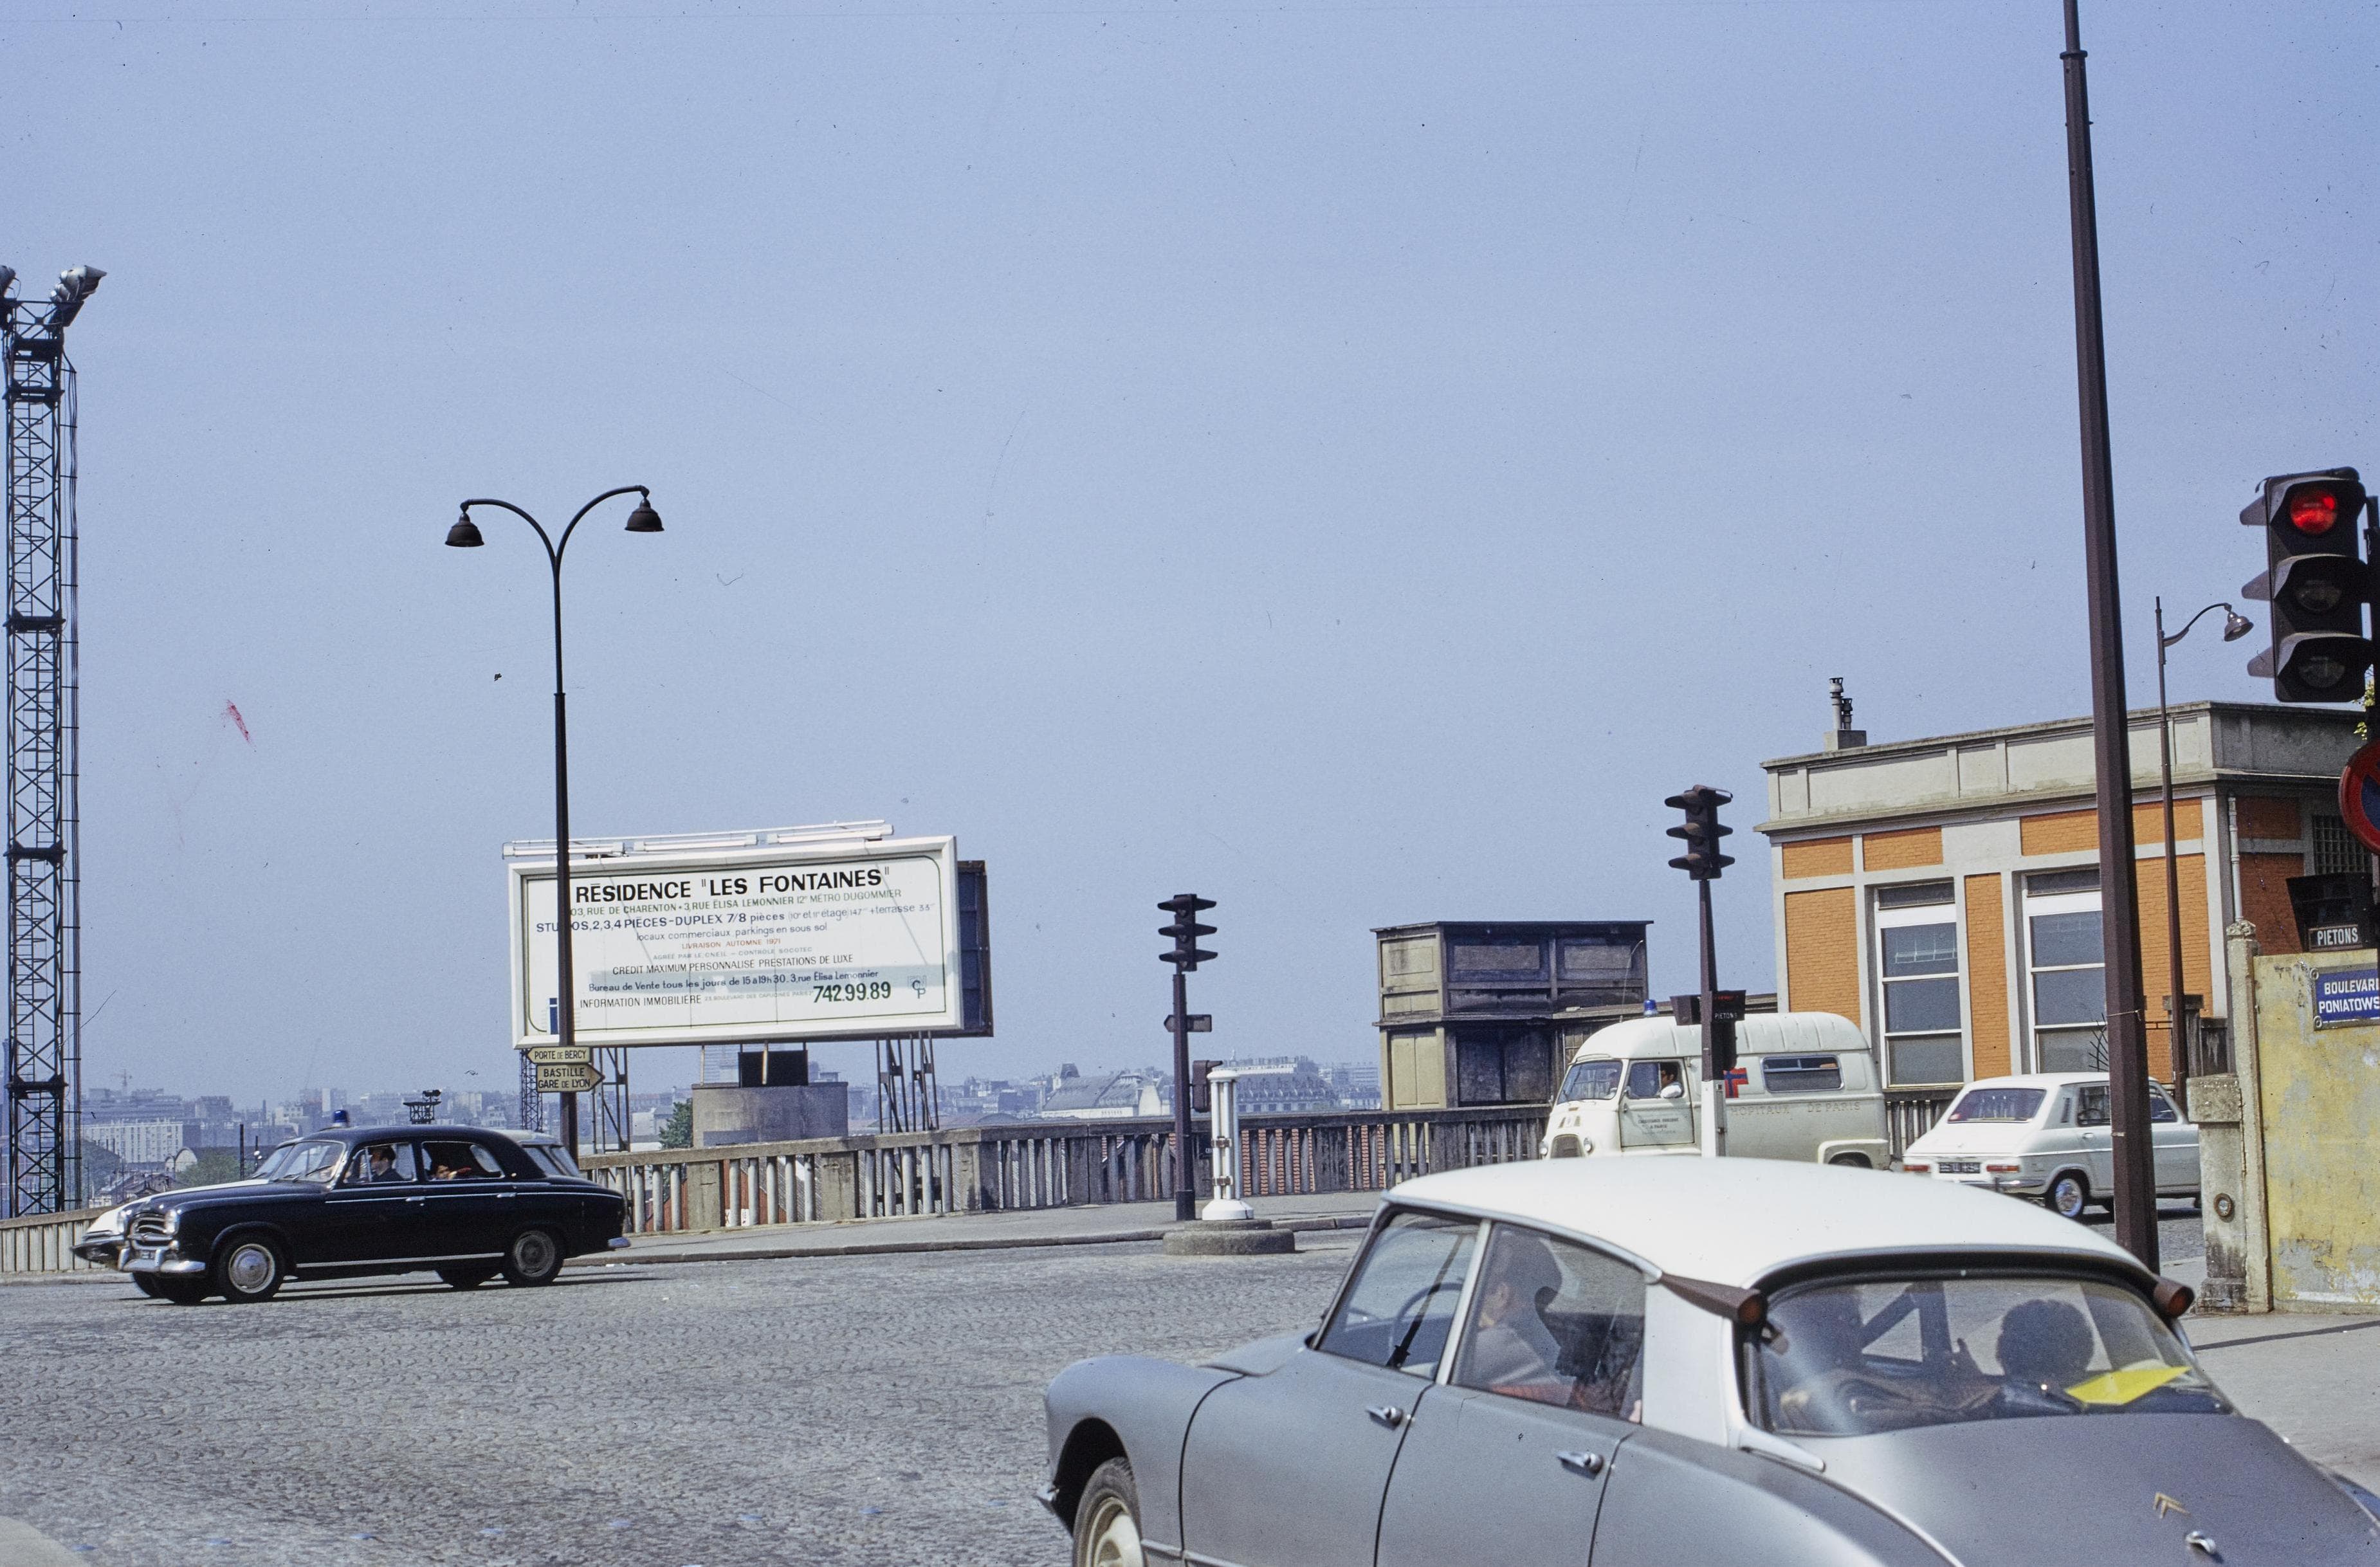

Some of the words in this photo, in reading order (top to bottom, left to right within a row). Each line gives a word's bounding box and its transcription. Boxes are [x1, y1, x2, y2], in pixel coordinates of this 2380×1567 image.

[576, 881, 691, 903] RÉSIDENCE
[623, 903, 676, 913] CHARENTON
[742, 897, 794, 907] LEMONNIER
[843, 889, 901, 901] DUGOMMIER
[727, 913, 746, 923] 7/8
[750, 912, 785, 924] pièces
[803, 910, 811, 919] et
[637, 932, 664, 941] locaux
[668, 928, 731, 939] commerciaux
[735, 925, 774, 938] parkings
[790, 924, 811, 933] sous
[814, 922, 827, 931] sol
[2317, 927, 2358, 946] PIETONS
[646, 964, 686, 973] MAXIMUM
[759, 956, 816, 967] PRESTATIONS
[819, 955, 830, 964] DE
[833, 954, 854, 964] LUXE
[589, 982, 619, 992] Bureau
[623, 981, 632, 991] de
[635, 980, 660, 990] Vente
[663, 980, 683, 989] tous
[686, 979, 699, 987] les
[700, 978, 726, 990] jours
[729, 976, 740, 985] de
[742, 975, 751, 985] 15
[836, 969, 879, 980] Lemonnier
[580, 997, 640, 1009] INFORMATION
[813, 981, 891, 1003] 742.99.89
[535, 1050, 555, 1059] PORTE
[565, 1049, 586, 1058] BERCY
[544, 1067, 585, 1077] BASTILLE
[538, 1079, 559, 1088] GARE
[572, 1079, 590, 1087] LYON
[1825, 1101, 1861, 1112] PARIS
